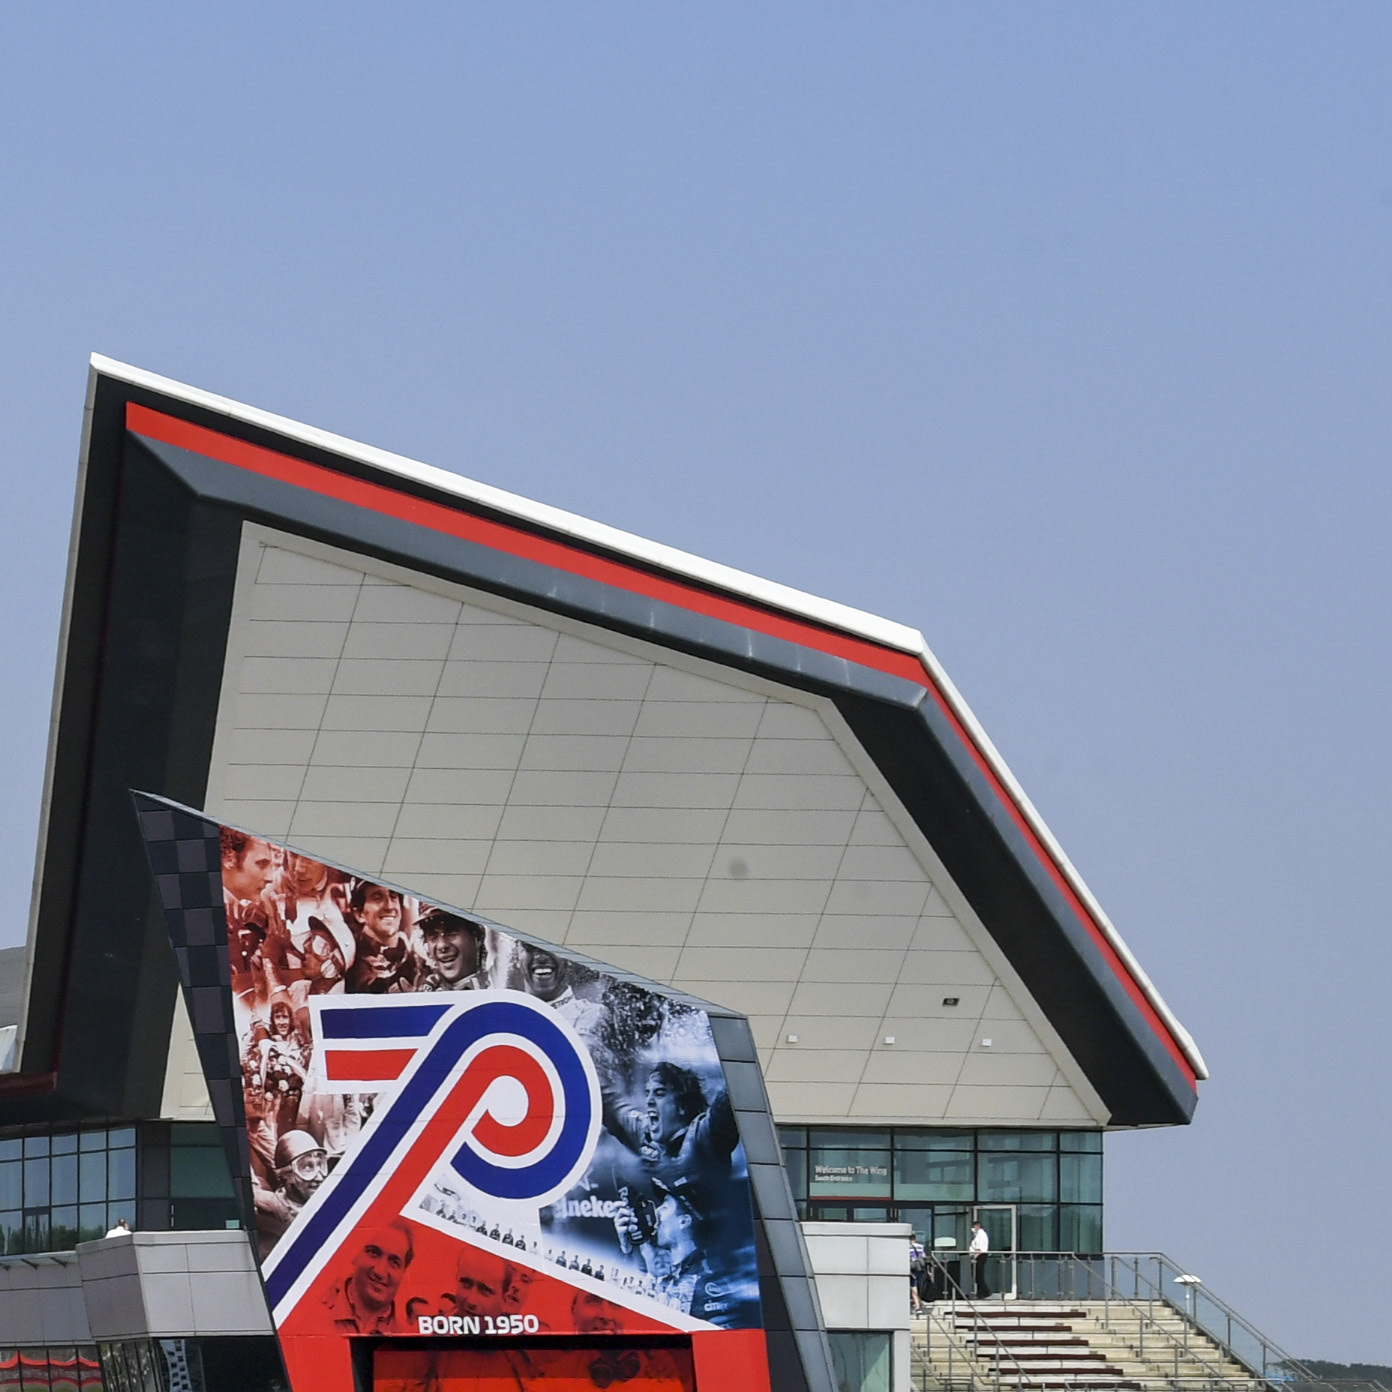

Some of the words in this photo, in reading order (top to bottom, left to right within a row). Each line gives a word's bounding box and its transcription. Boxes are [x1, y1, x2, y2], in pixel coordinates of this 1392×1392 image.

[814, 1165, 847, 1174] Welcome
[848, 1166, 855, 1174] to
[856, 1166, 869, 1175] The
[869, 1166, 888, 1176] Wing
[418, 1315, 481, 1335] BORN
[484, 1314, 540, 1335] 1950
